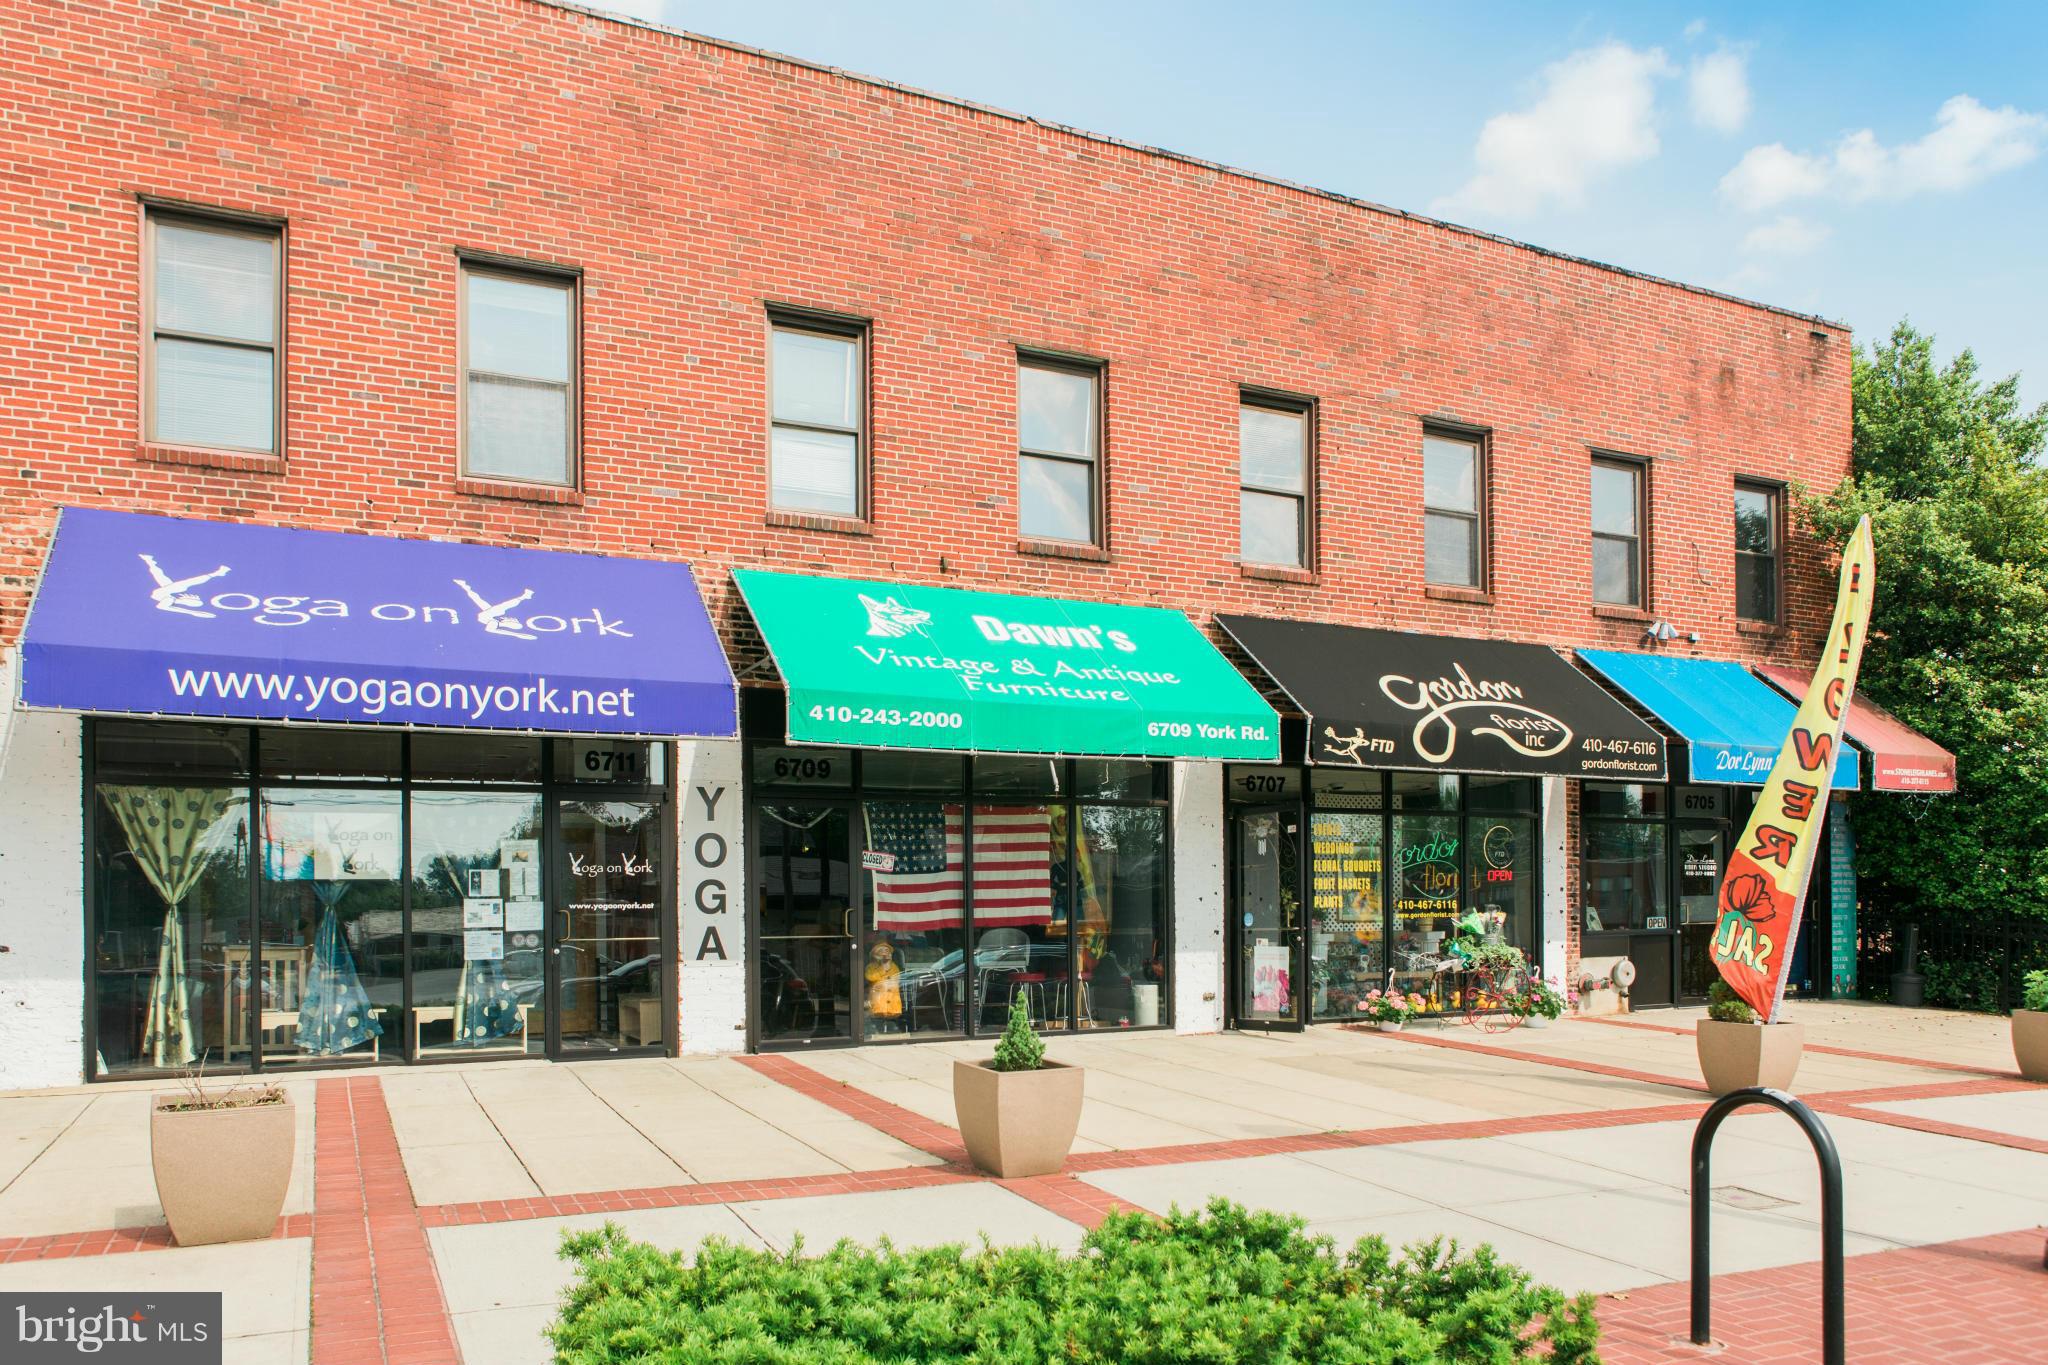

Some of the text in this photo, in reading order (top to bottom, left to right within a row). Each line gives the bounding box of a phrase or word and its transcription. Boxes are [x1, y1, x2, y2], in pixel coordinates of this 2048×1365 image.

[138, 553, 634, 641] Yoga on York
[971, 614, 1137, 653] Dawn's
[853, 645, 1181, 686] Vintage & Antique
[168, 668, 636, 720] www.yogaonyork.net
[957, 673, 1131, 701] Furniture
[809, 704, 963, 729] 410-243-2000
[1490, 713, 1560, 733] florist
[1147, 722, 1270, 741] 6709 York Rd.
[1525, 731, 1546, 748] inc
[1370, 738, 1395, 754] FTD
[1581, 738, 1657, 756] 410-467-6116
[584, 750, 636, 772] 6711
[774, 757, 832, 779] 6709
[1581, 758, 1657, 772] gordonflorist.com
[1716, 750, 1742, 771] Dor
[1741, 751, 1773, 776] Lynn
[1246, 775, 1287, 793] 6707
[1685, 795, 1715, 810] 6705
[1313, 841, 1355, 855] WEDDINGS
[568, 852, 654, 878] Yoga on York
[694, 786, 728, 961] YOGA
[1313, 859, 1382, 873] FLORAL BOUQUETS
[1313, 877, 1371, 891] FRUIT BASKETS
[1487, 869, 1513, 881] OPEN
[568, 902, 655, 912] www.yogaonyork.net
[1313, 895, 1343, 909] PLANTS
[1398, 899, 1458, 910] 410-467-6116
[1648, 918, 1666, 928] OPEN
